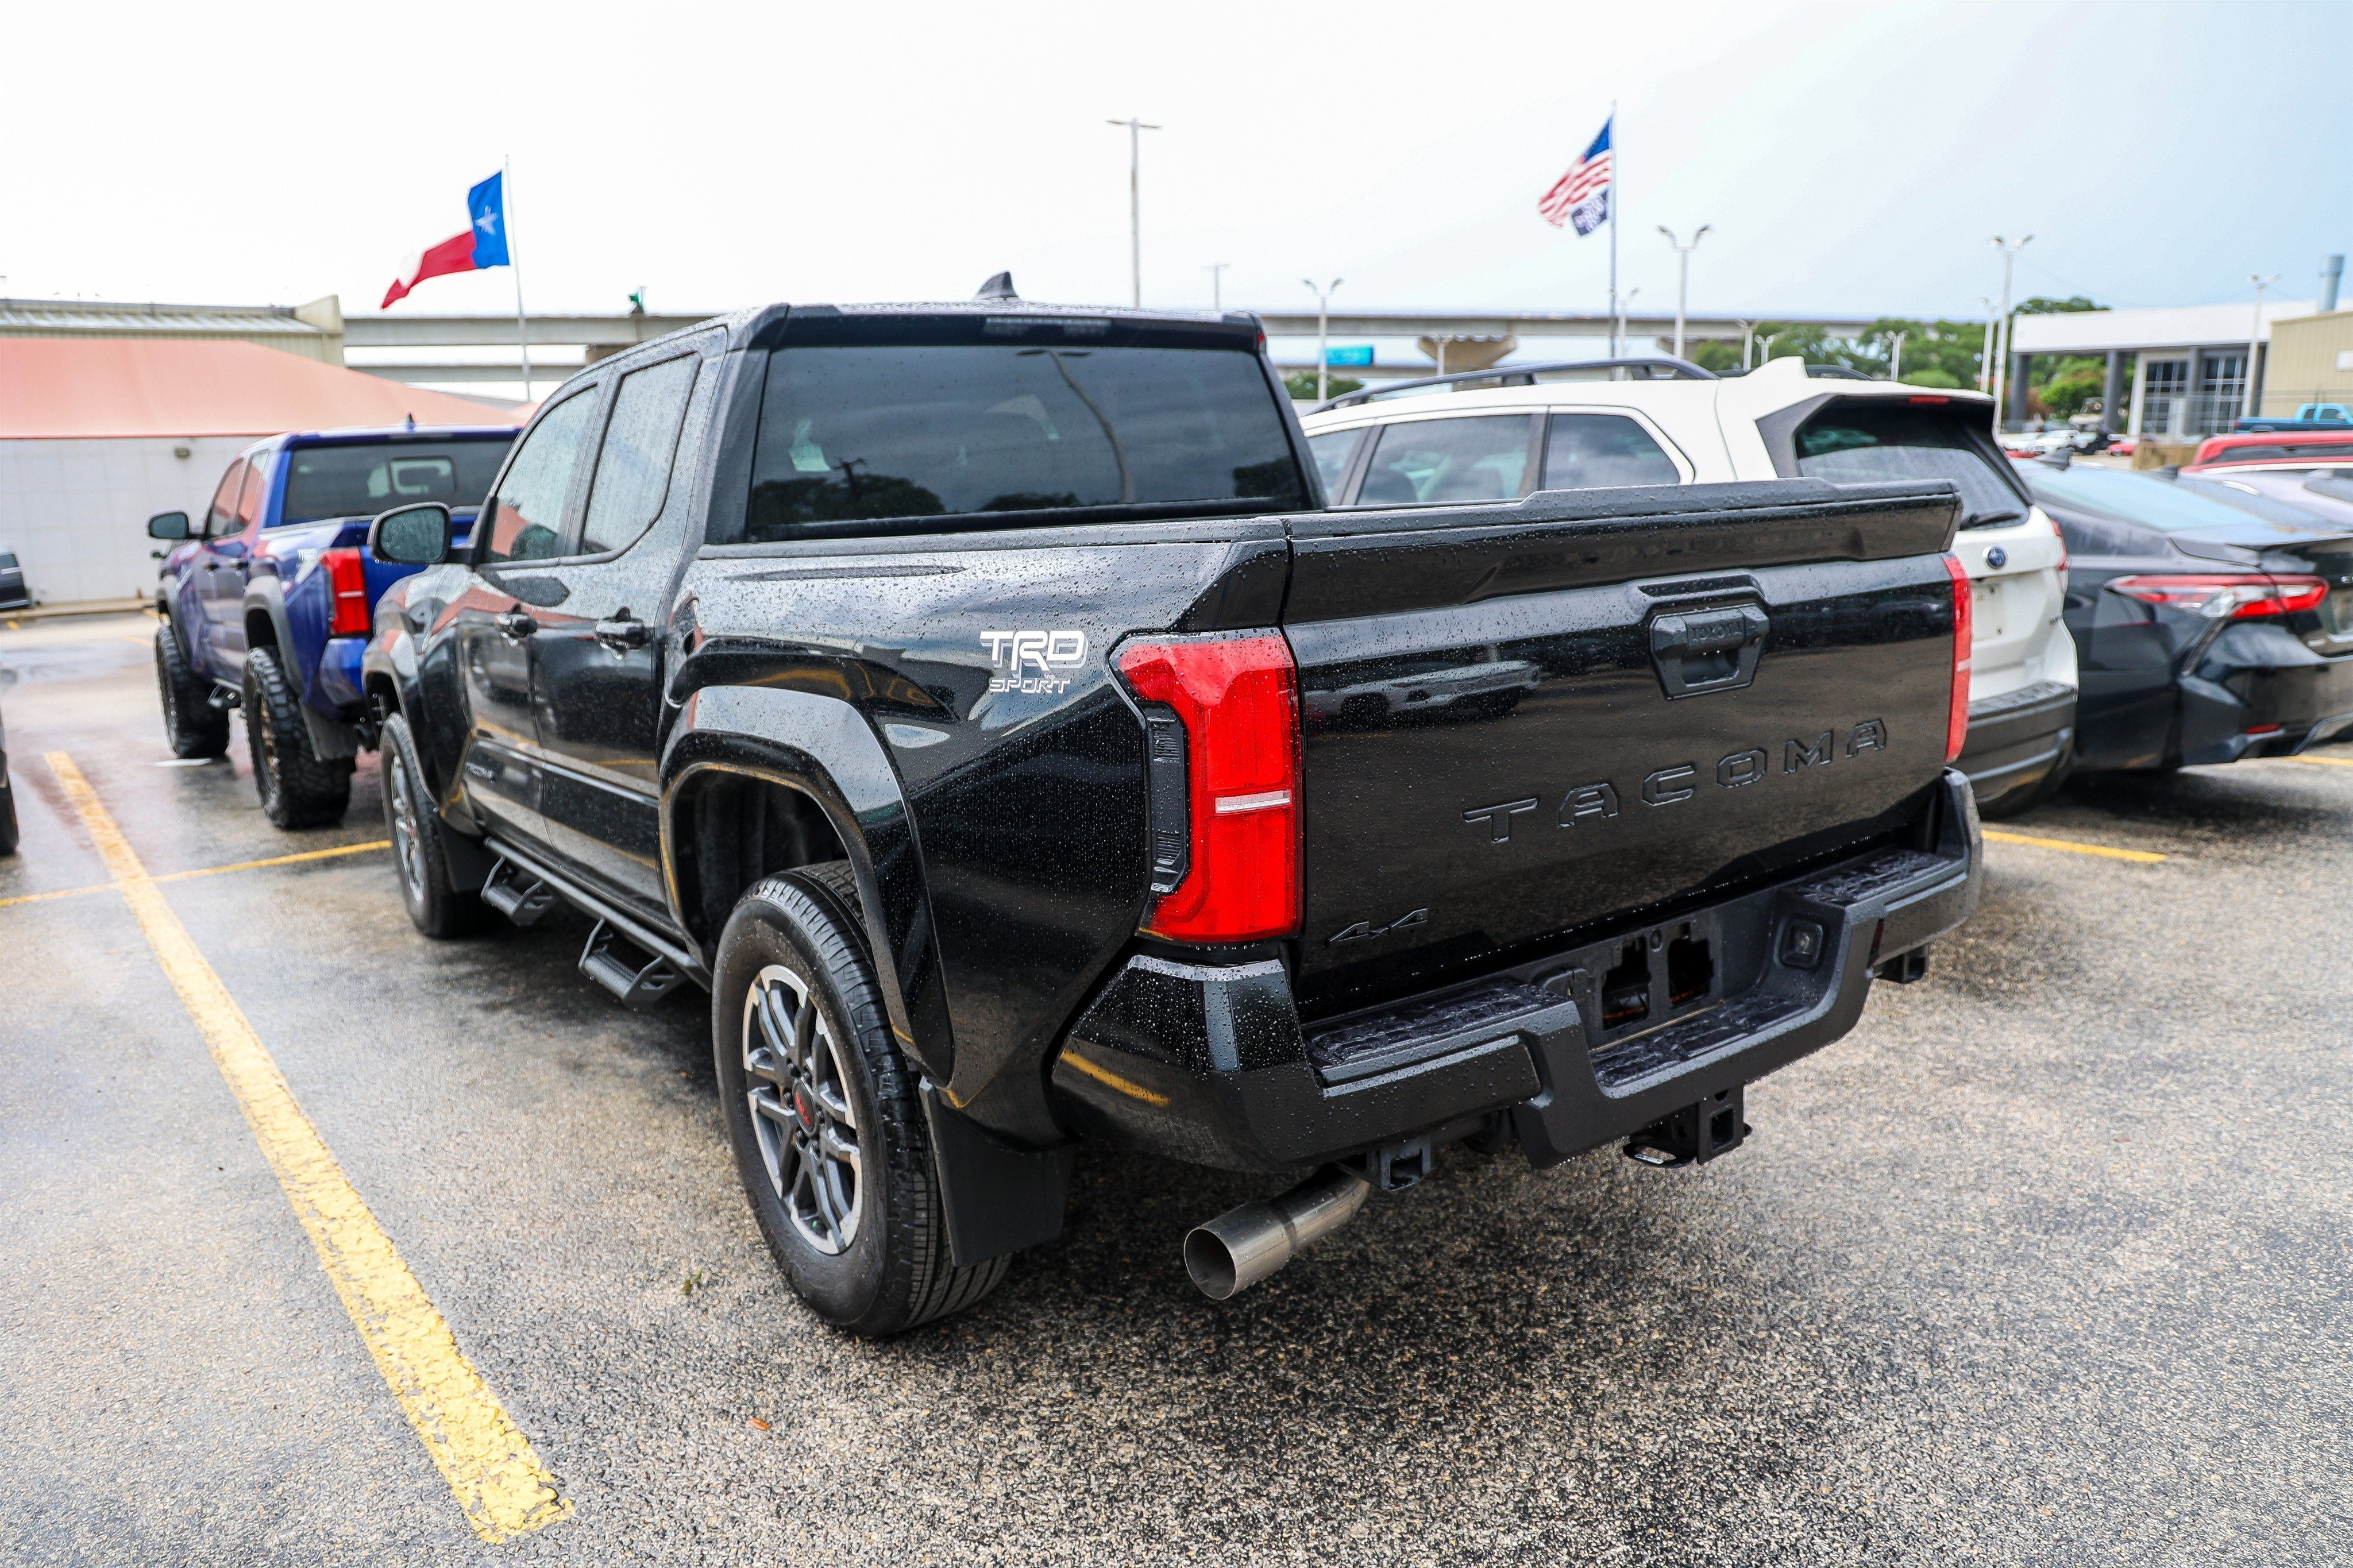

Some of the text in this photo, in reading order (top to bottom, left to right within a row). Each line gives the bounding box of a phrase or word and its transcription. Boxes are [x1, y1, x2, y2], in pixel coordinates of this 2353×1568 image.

[979, 631, 1089, 678] TRD
[989, 676, 1070, 694] SPORT
[1462, 718, 1888, 844] TACOMA
